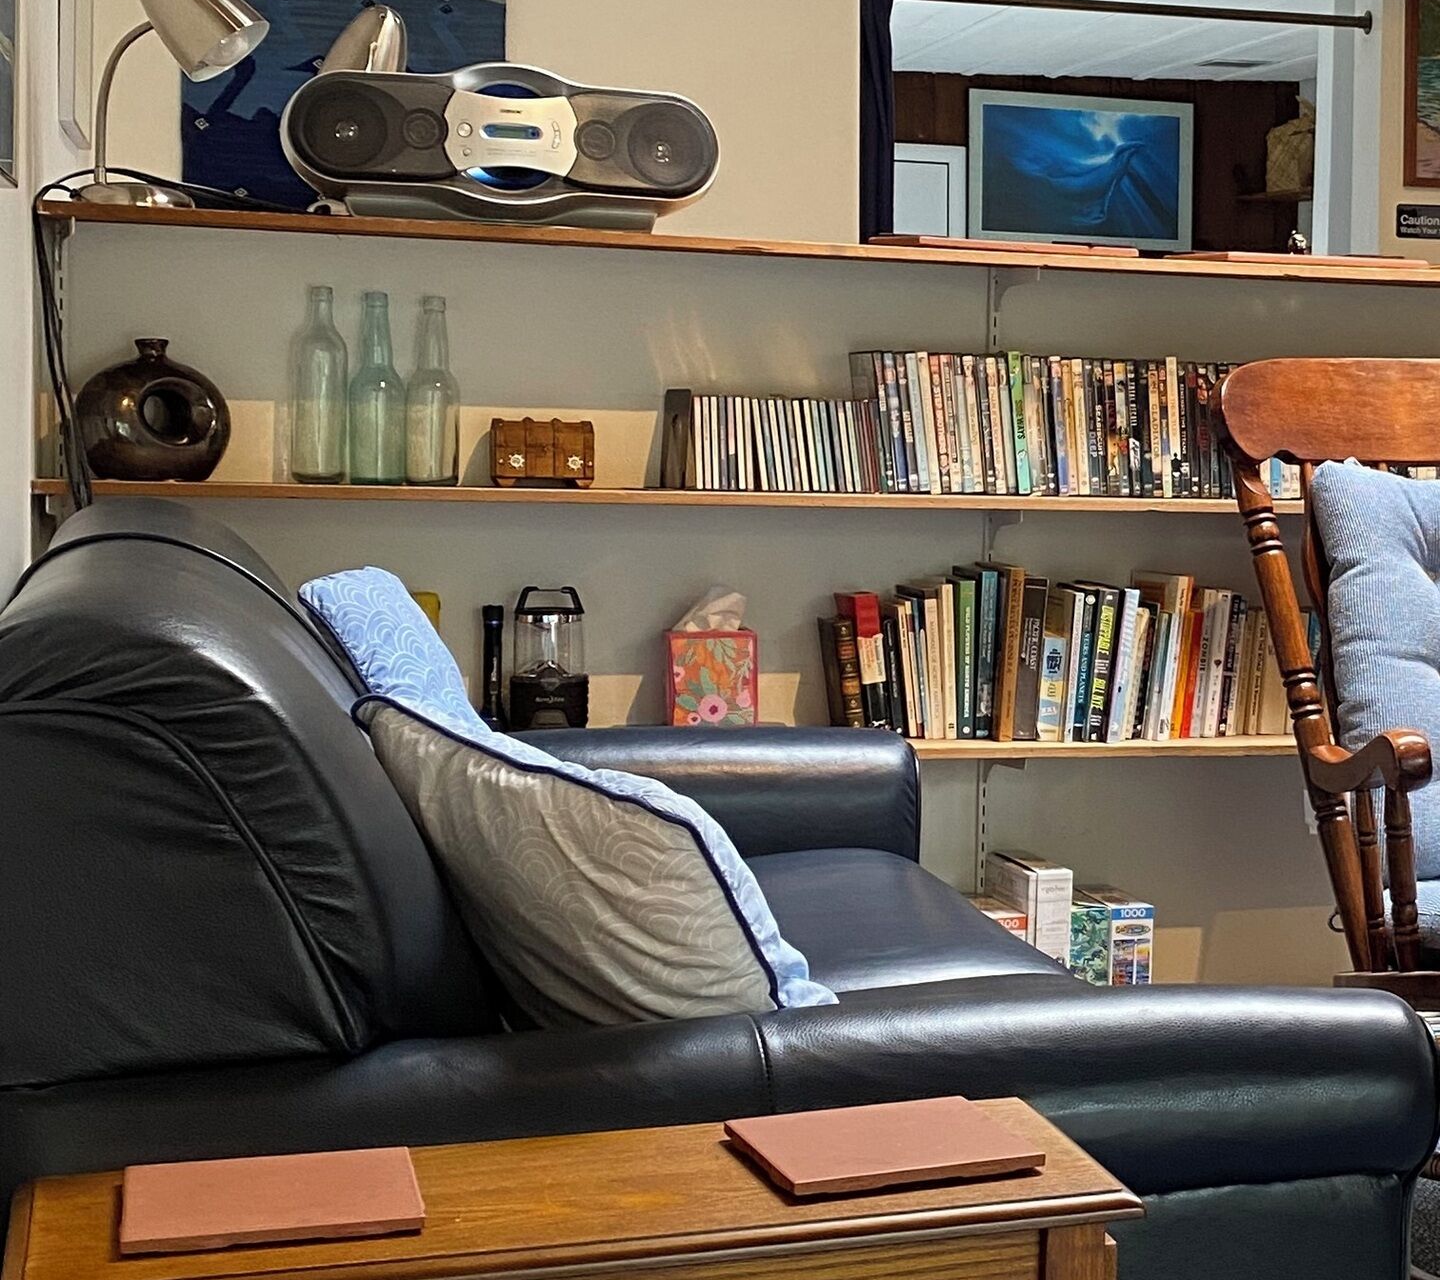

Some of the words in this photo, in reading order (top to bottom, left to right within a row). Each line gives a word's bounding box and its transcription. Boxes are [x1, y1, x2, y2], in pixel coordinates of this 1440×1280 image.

[1400, 214, 1440, 226] Caution
[1422, 227, 1438, 235] Your
[1015, 400, 1026, 440] SIDEWAYS
[1151, 403, 1160, 459] GLADIATOR
[1089, 431, 1097, 458] DEEP
[1097, 605, 1114, 655] UNSTOPPABLE
[1200, 637, 1209, 672] ZOMBIE
[1120, 908, 1146, 918] 1000
